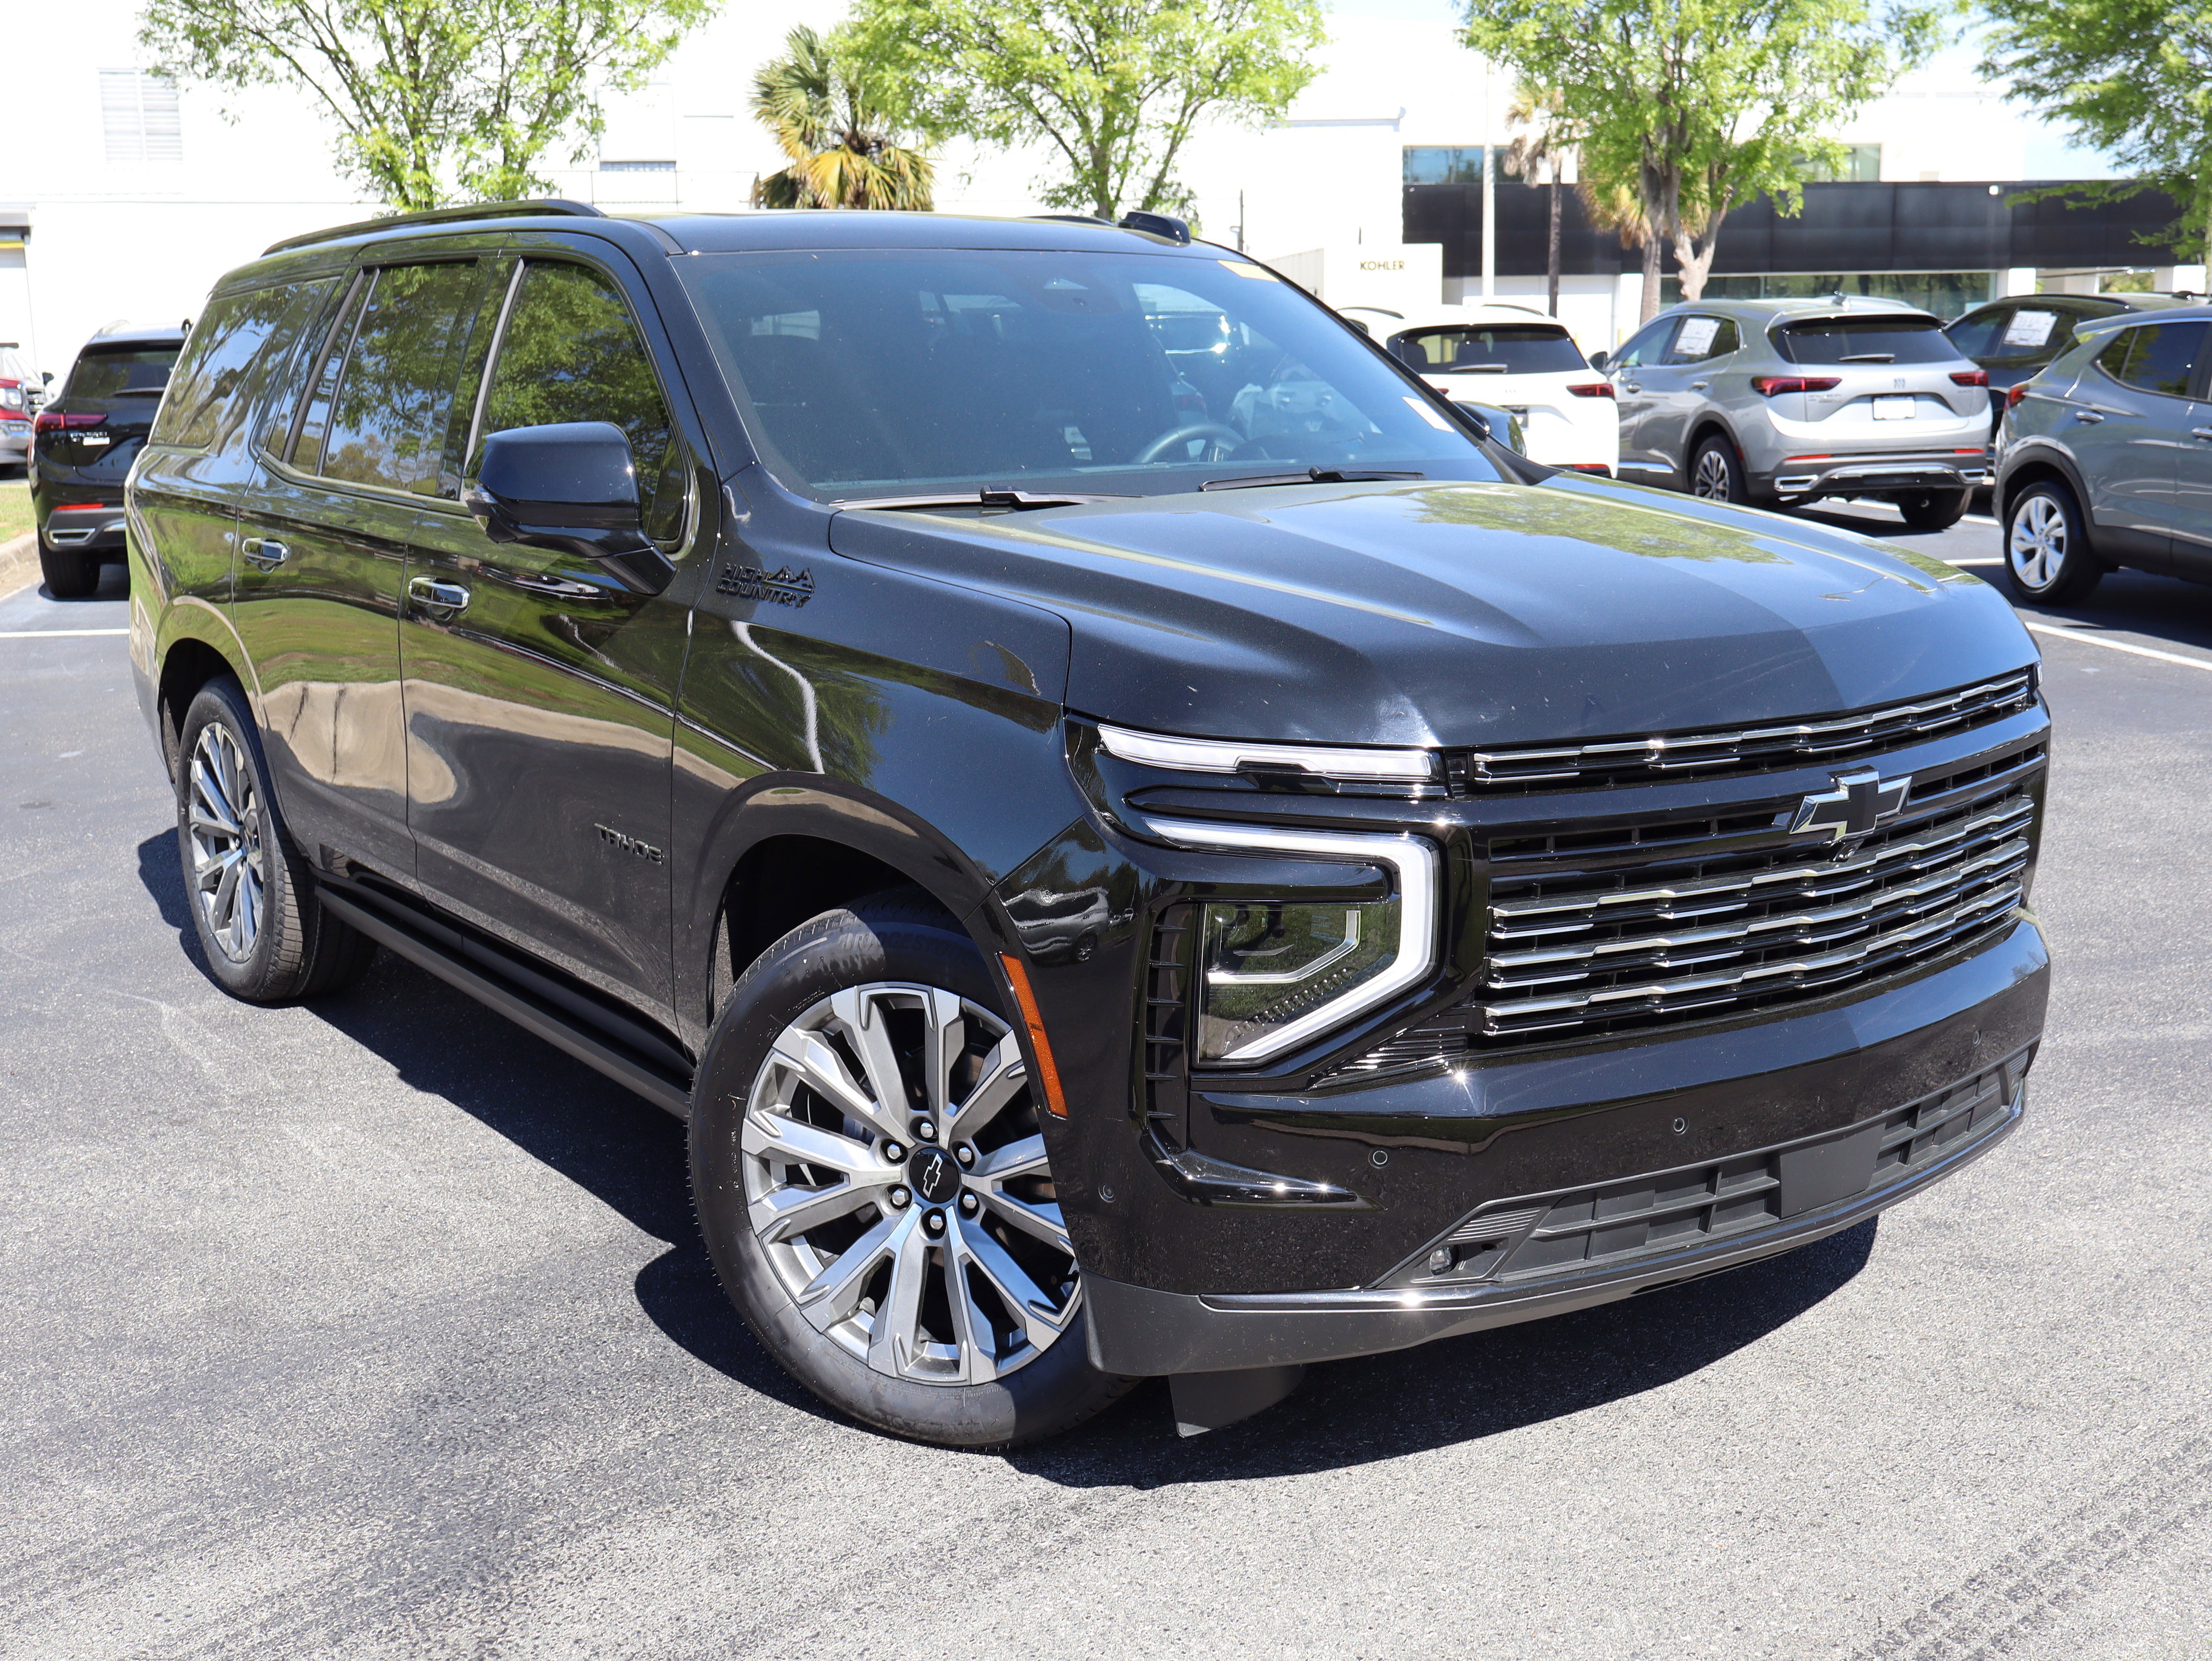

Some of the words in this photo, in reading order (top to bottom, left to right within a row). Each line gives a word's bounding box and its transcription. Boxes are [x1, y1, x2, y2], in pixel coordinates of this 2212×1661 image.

[1360, 260, 1405, 271] KOHLER
[722, 562, 770, 582] HIGH
[716, 577, 812, 608] COUNTRY
[594, 822, 663, 866] TAHOE
